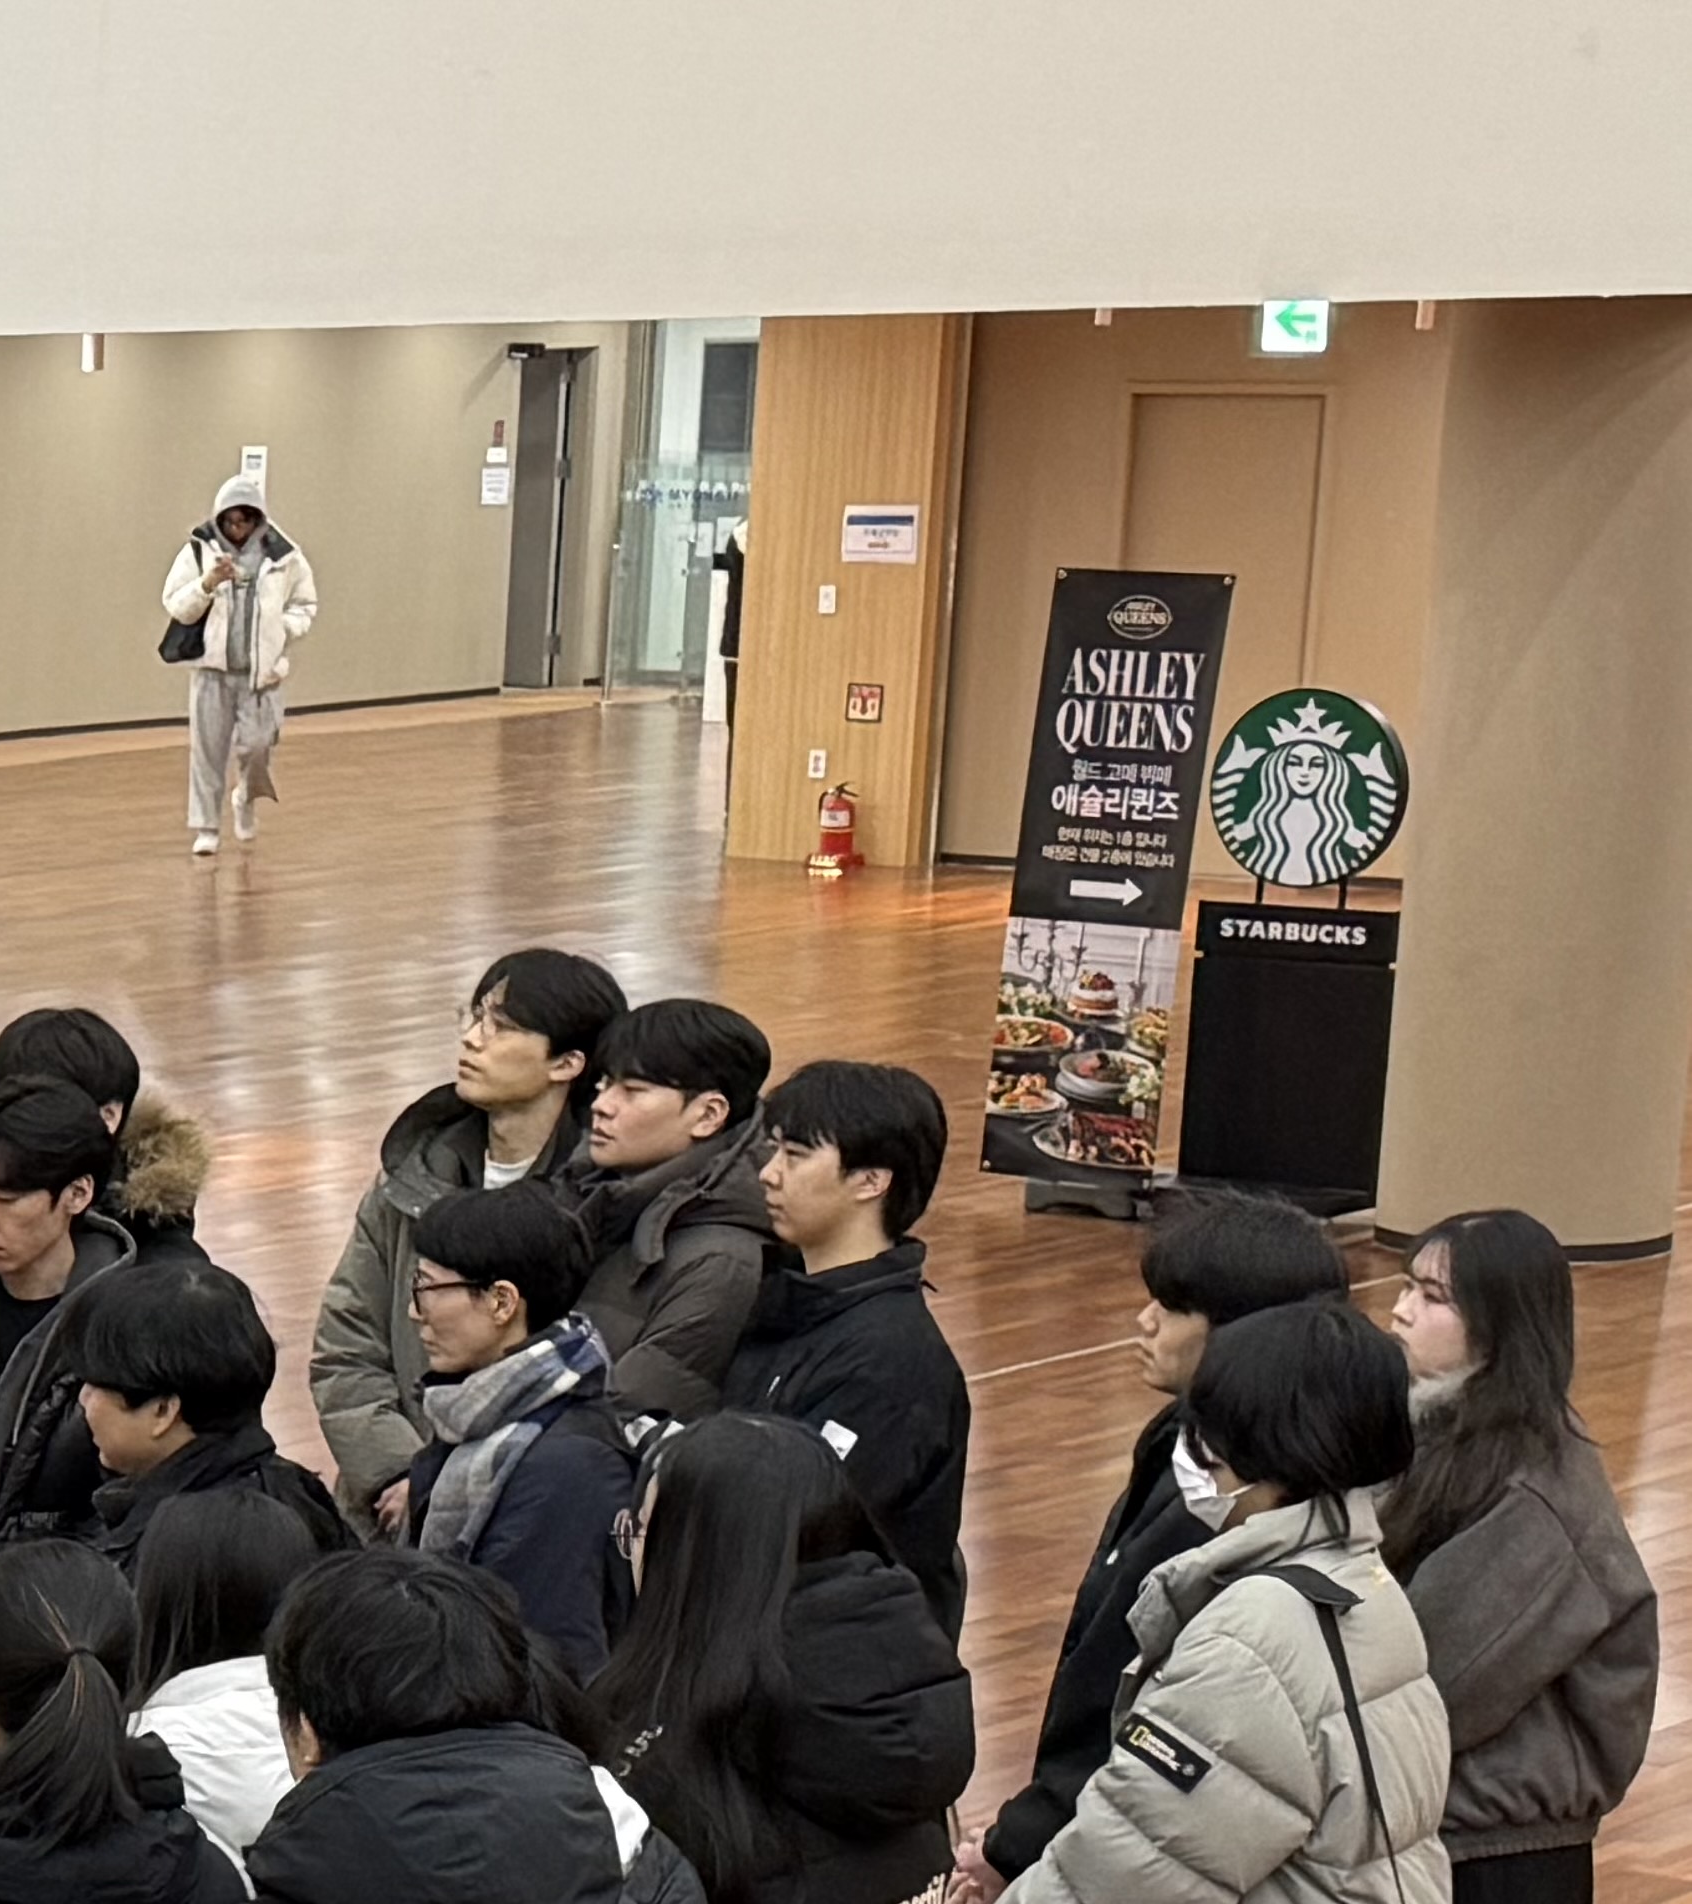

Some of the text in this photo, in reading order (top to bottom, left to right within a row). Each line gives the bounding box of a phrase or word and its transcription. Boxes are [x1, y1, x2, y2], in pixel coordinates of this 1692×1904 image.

[1114, 612, 1167, 625] QUEENS
[1061, 647, 1207, 701] ASHLEY
[1056, 698, 1195, 754] QUEENS
[1051, 784, 1181, 821] 애슐리퀸즈
[1219, 918, 1367, 946] STARBUCKS
